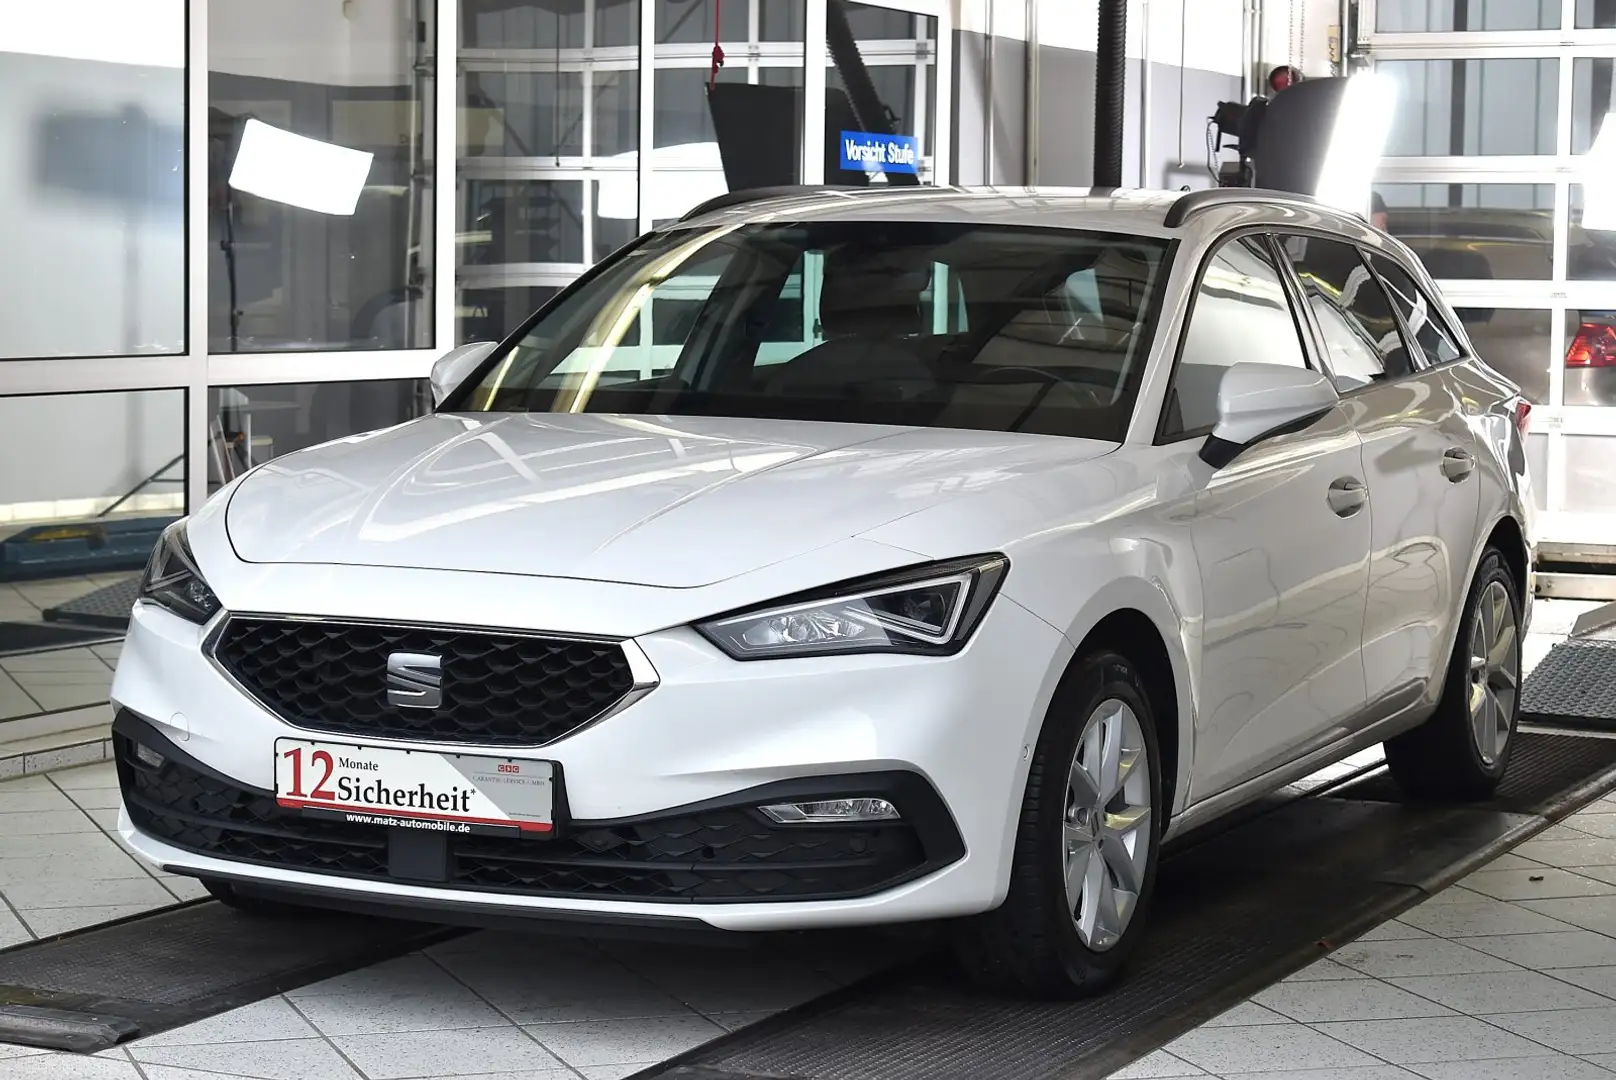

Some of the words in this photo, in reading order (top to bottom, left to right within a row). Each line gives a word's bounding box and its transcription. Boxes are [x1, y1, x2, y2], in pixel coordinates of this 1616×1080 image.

[845, 139, 886, 163] Vorsicht
[887, 142, 914, 164] Stufe
[284, 747, 335, 801] 12
[338, 757, 379, 771] Monate
[346, 814, 471, 833] www.matz-automobile.de
